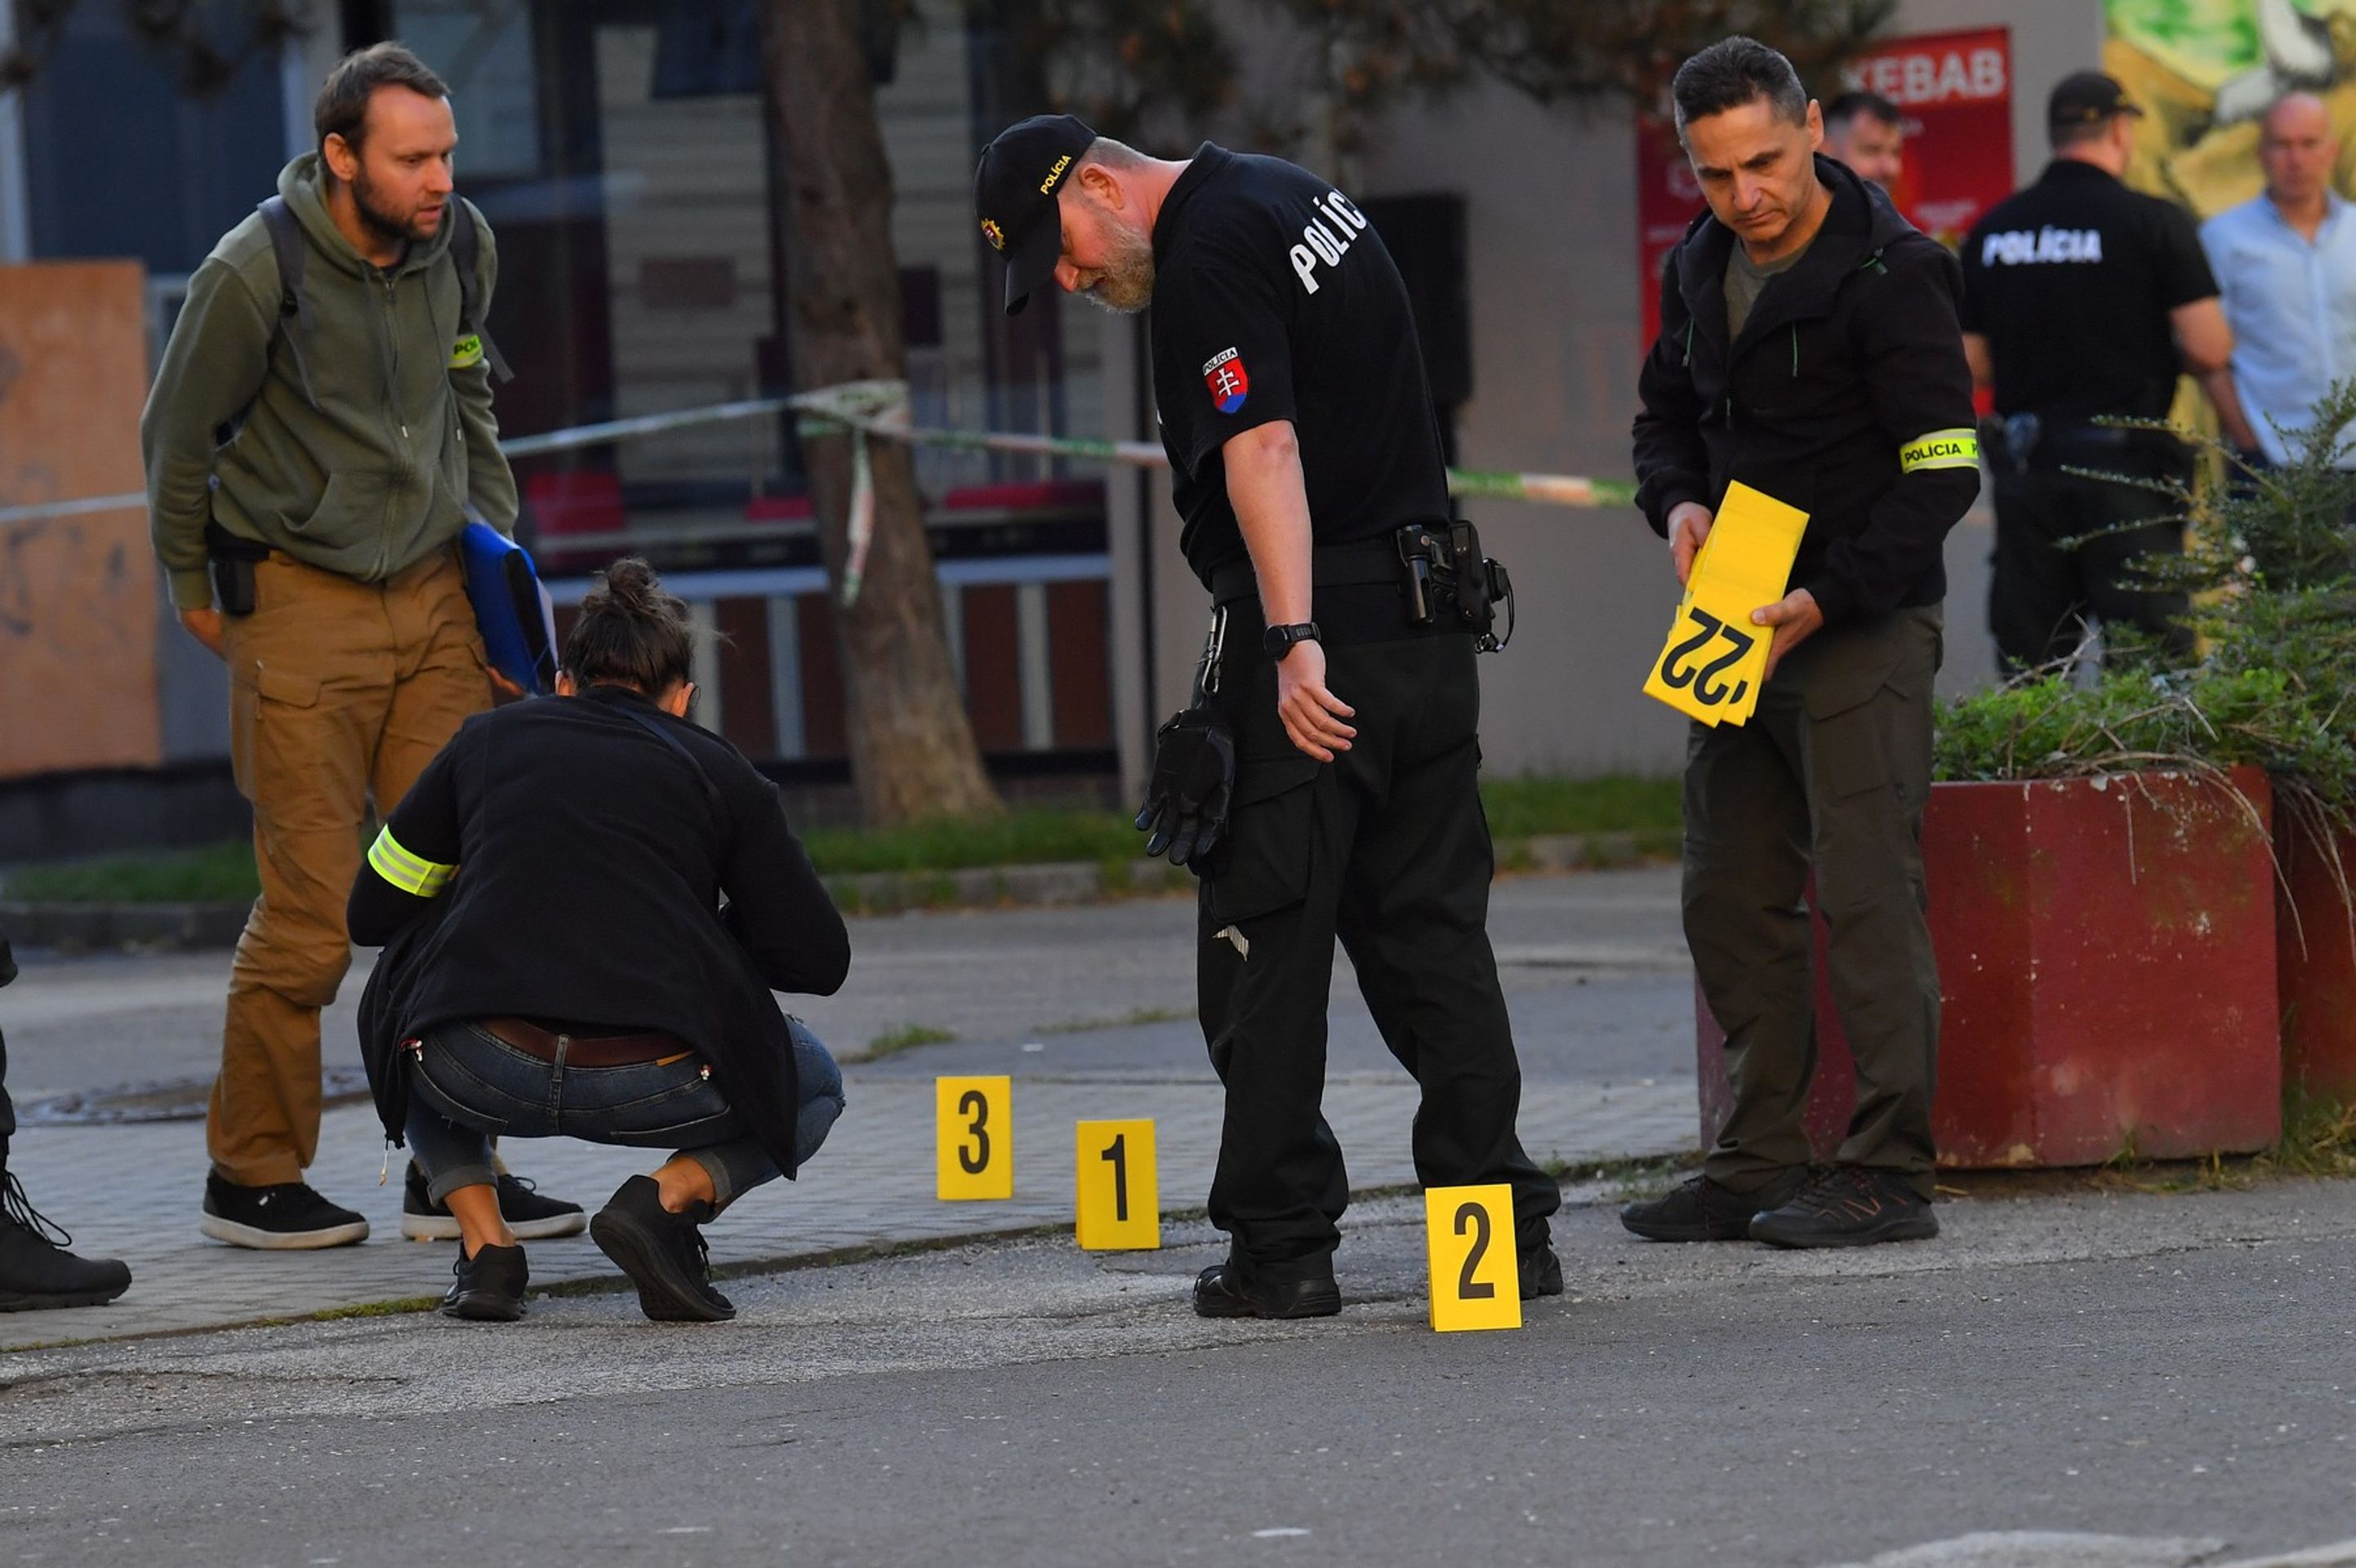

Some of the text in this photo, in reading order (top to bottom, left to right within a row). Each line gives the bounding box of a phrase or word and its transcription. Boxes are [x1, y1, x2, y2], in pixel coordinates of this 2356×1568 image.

[1840, 48, 2004, 105] KEBAB
[1040, 154, 1072, 195] POLÍCIA
[1289, 188, 1367, 295] POLÍC
[1981, 224, 2102, 267] POLÍCIA
[1661, 607, 1754, 706] 22
[958, 1089, 991, 1174] 3
[1101, 1134, 1129, 1223] 1
[1454, 1201, 1496, 1300] 2
